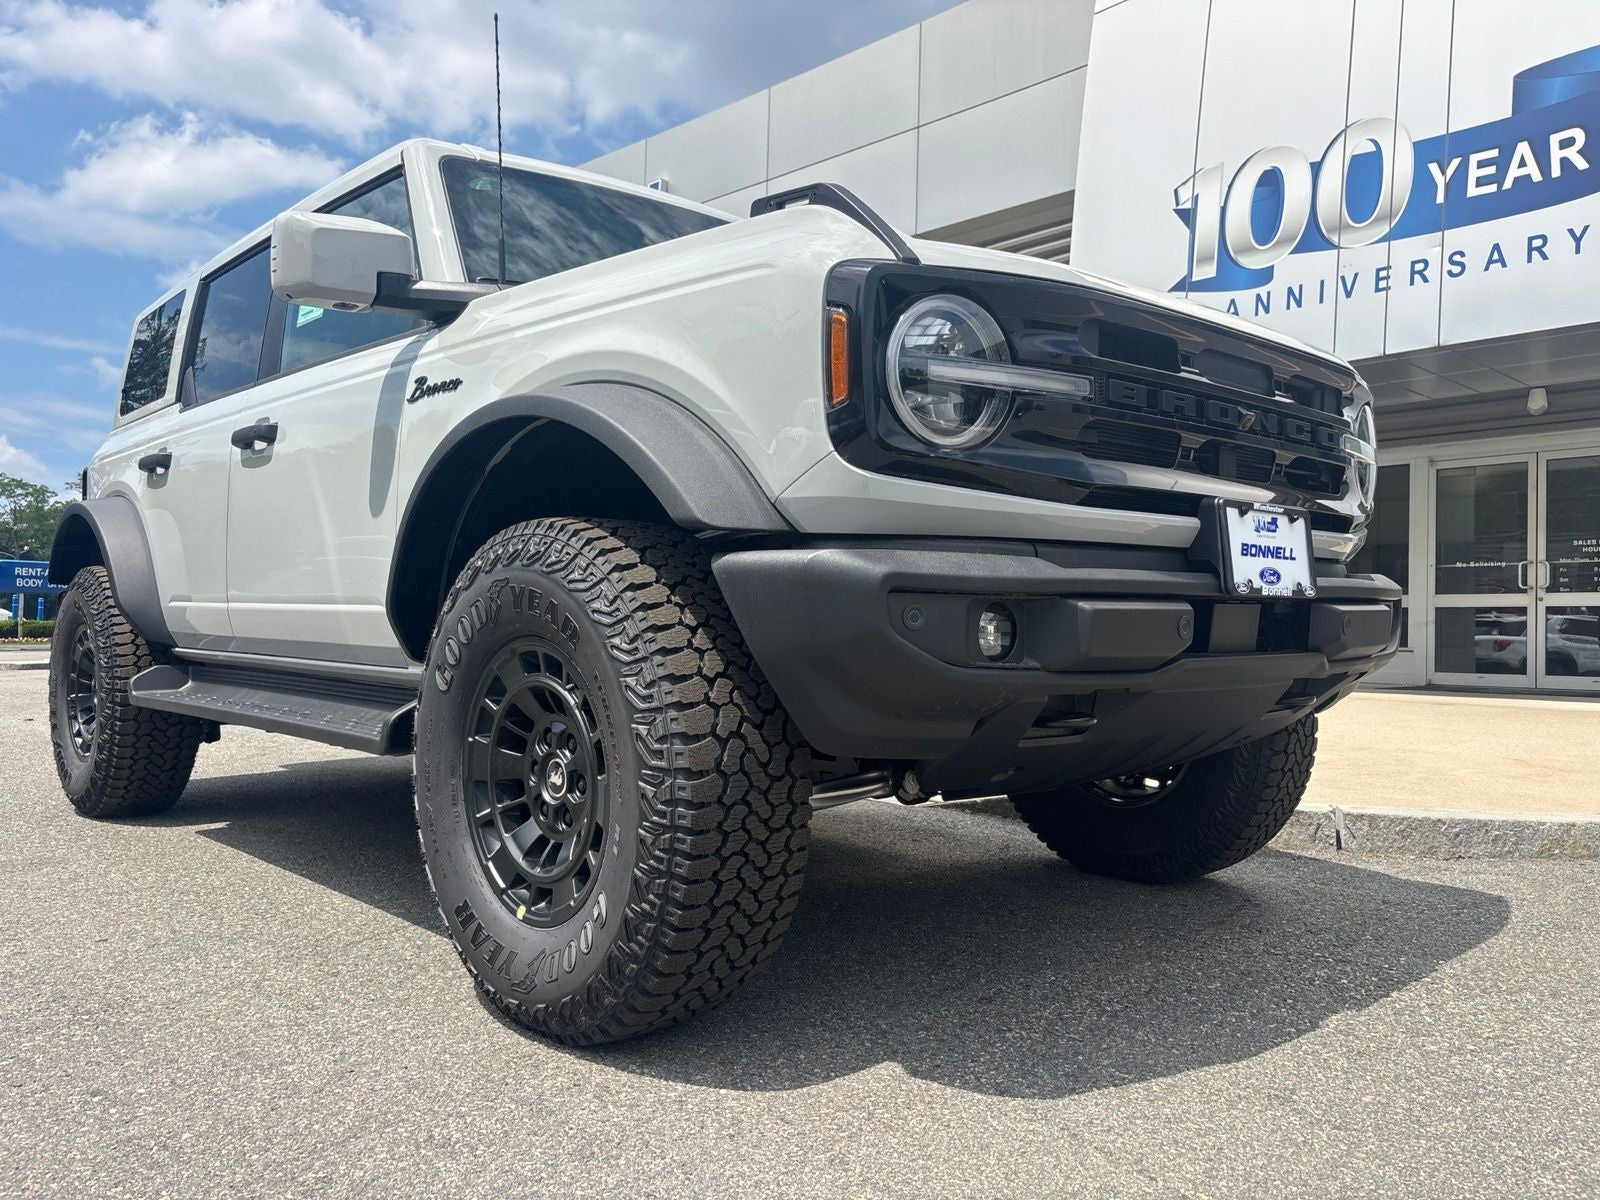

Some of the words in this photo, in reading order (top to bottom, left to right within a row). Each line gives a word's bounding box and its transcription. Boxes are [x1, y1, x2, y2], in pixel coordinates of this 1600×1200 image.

[1173, 117, 1414, 282] 100
[1427, 126, 1590, 205] YEAR
[1226, 224, 1591, 316] ANNIVERSARY
[406, 375, 463, 405] Bronco
[1104, 378, 1341, 447] BRONCO
[1240, 542, 1297, 561] BONNELL
[16, 578, 43, 587] BODY
[1261, 585, 1293, 597] Bonnell
